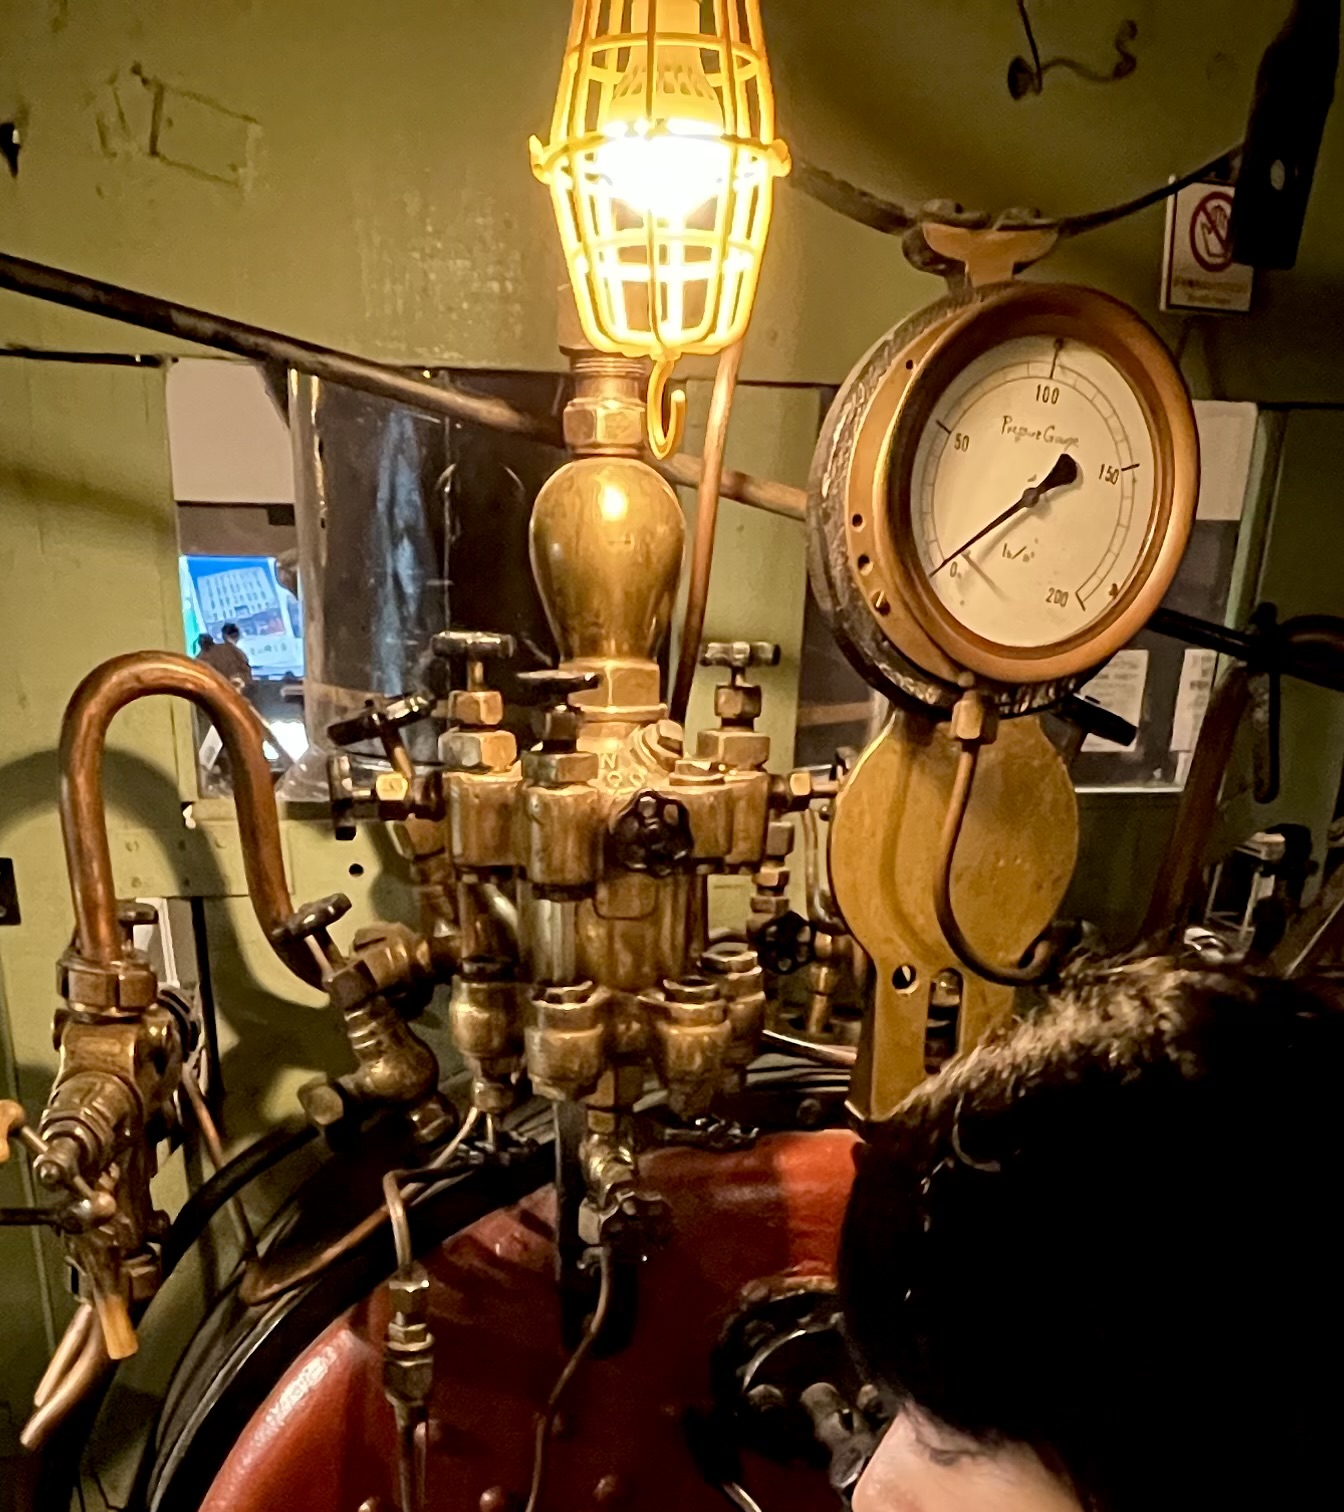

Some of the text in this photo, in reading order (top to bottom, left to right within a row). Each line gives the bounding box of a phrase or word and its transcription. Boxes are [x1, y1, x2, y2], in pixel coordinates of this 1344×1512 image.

[1036, 384, 1060, 405] 100
[954, 433, 970, 452] 50
[1098, 464, 1120, 486] 150
[1045, 587, 1069, 608] 200
